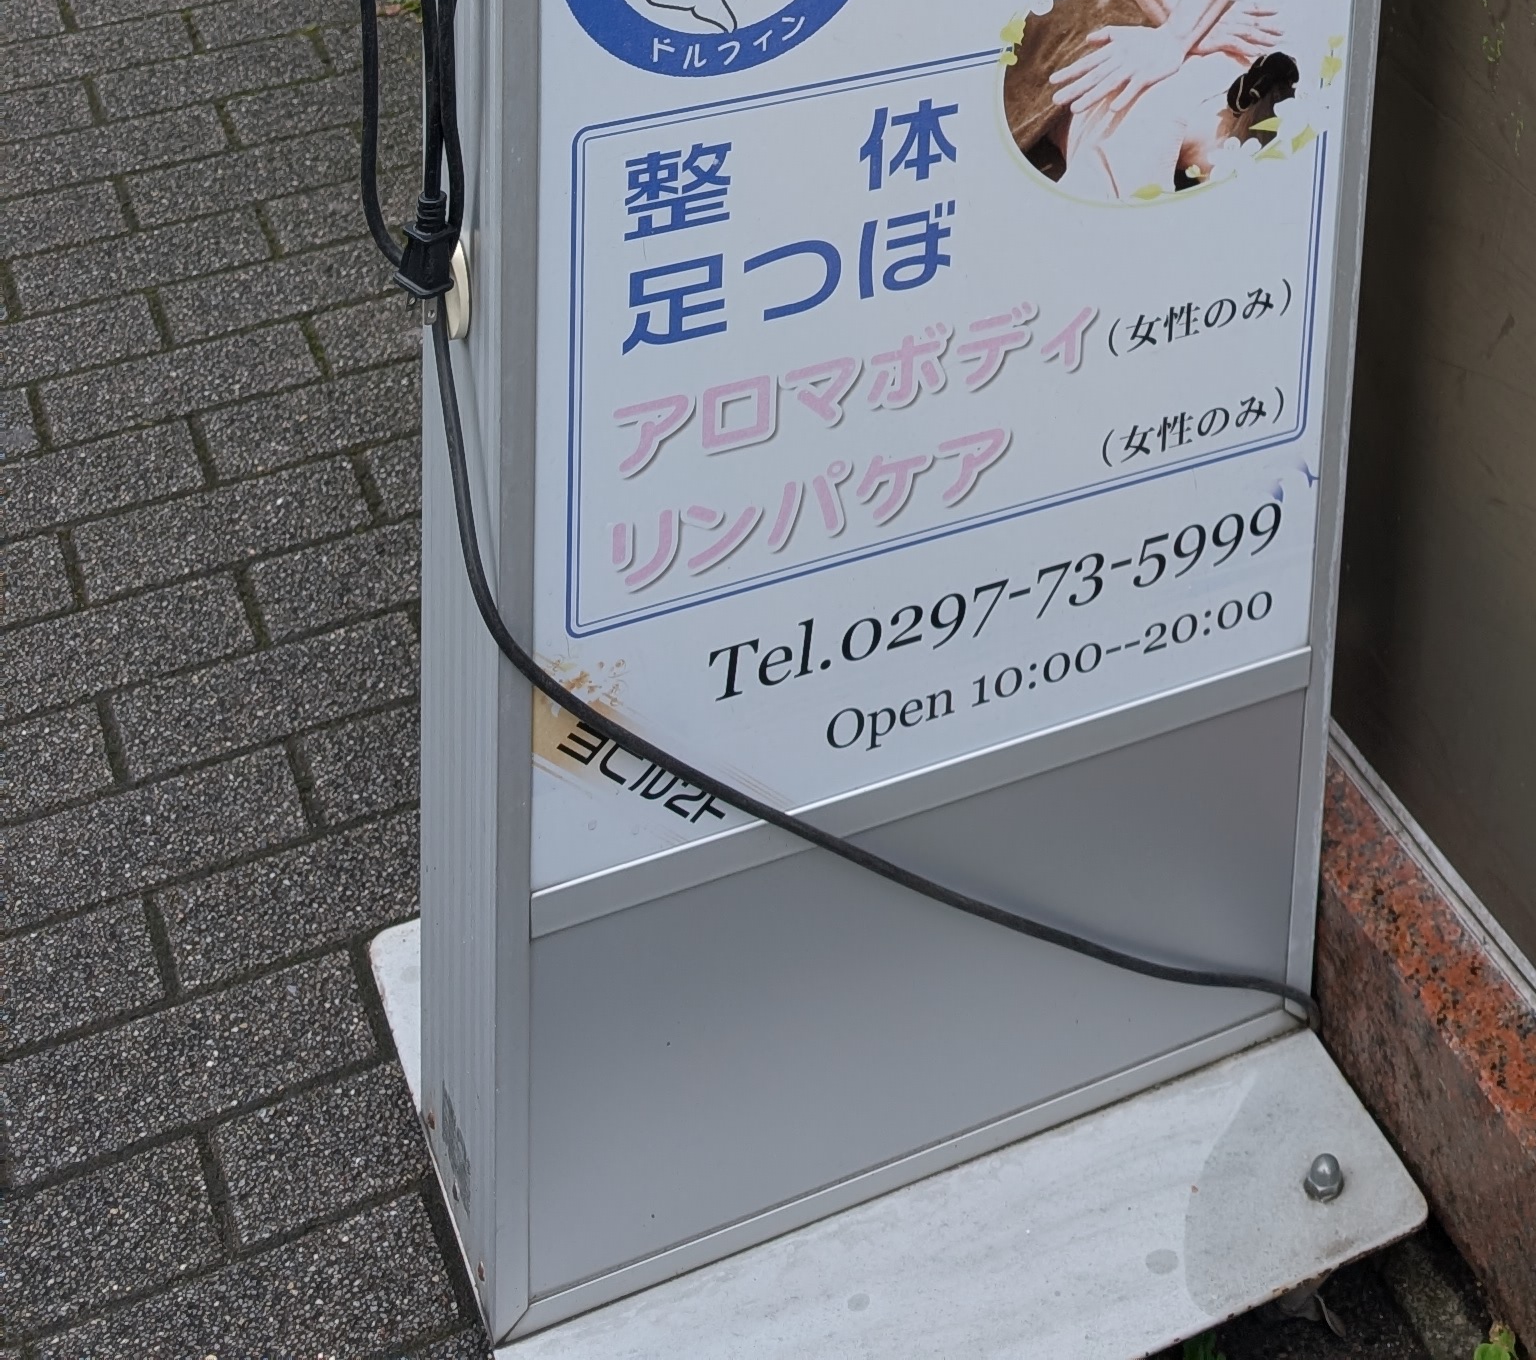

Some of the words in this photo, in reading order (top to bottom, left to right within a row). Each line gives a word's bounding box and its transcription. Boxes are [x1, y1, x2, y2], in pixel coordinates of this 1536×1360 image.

[653, 15, 805, 69] ドルフィン
[621, 199, 957, 357] 足つぼ
[610, 426, 1014, 591] リンパケア
[825, 689, 955, 753] Open
